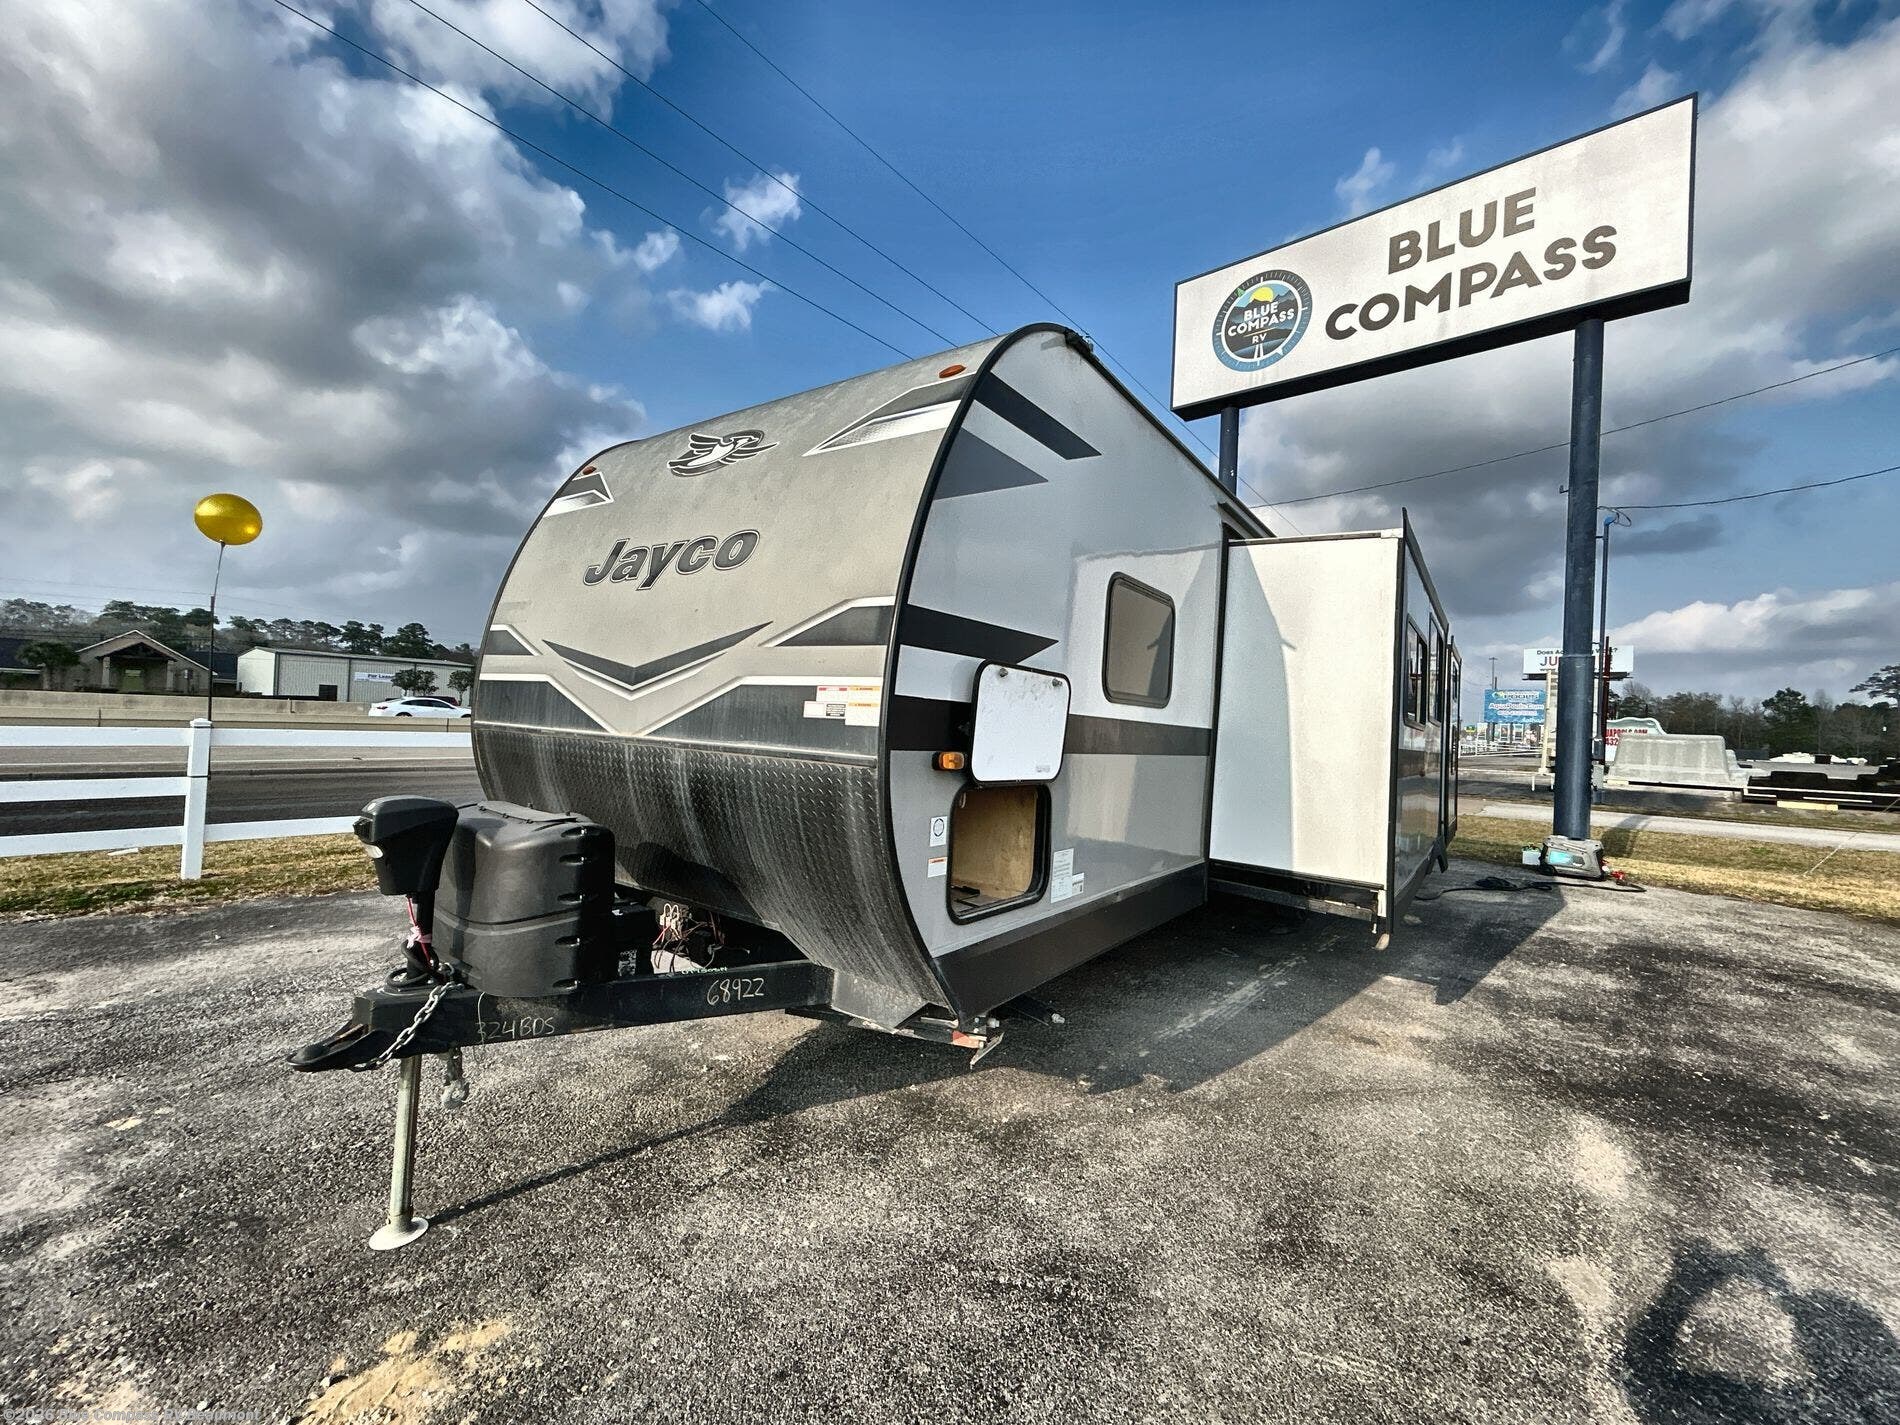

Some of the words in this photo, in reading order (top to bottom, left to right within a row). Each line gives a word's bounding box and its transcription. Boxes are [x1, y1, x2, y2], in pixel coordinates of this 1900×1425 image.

[1387, 187, 1537, 275] BLUE
[1325, 225, 1617, 340] COMPASS
[1228, 308, 1294, 336] COMPASS
[1244, 301, 1279, 321] BLUE
[1252, 333, 1267, 344] RV
[583, 529, 760, 591] Jayco
[706, 978, 764, 1005] 68922
